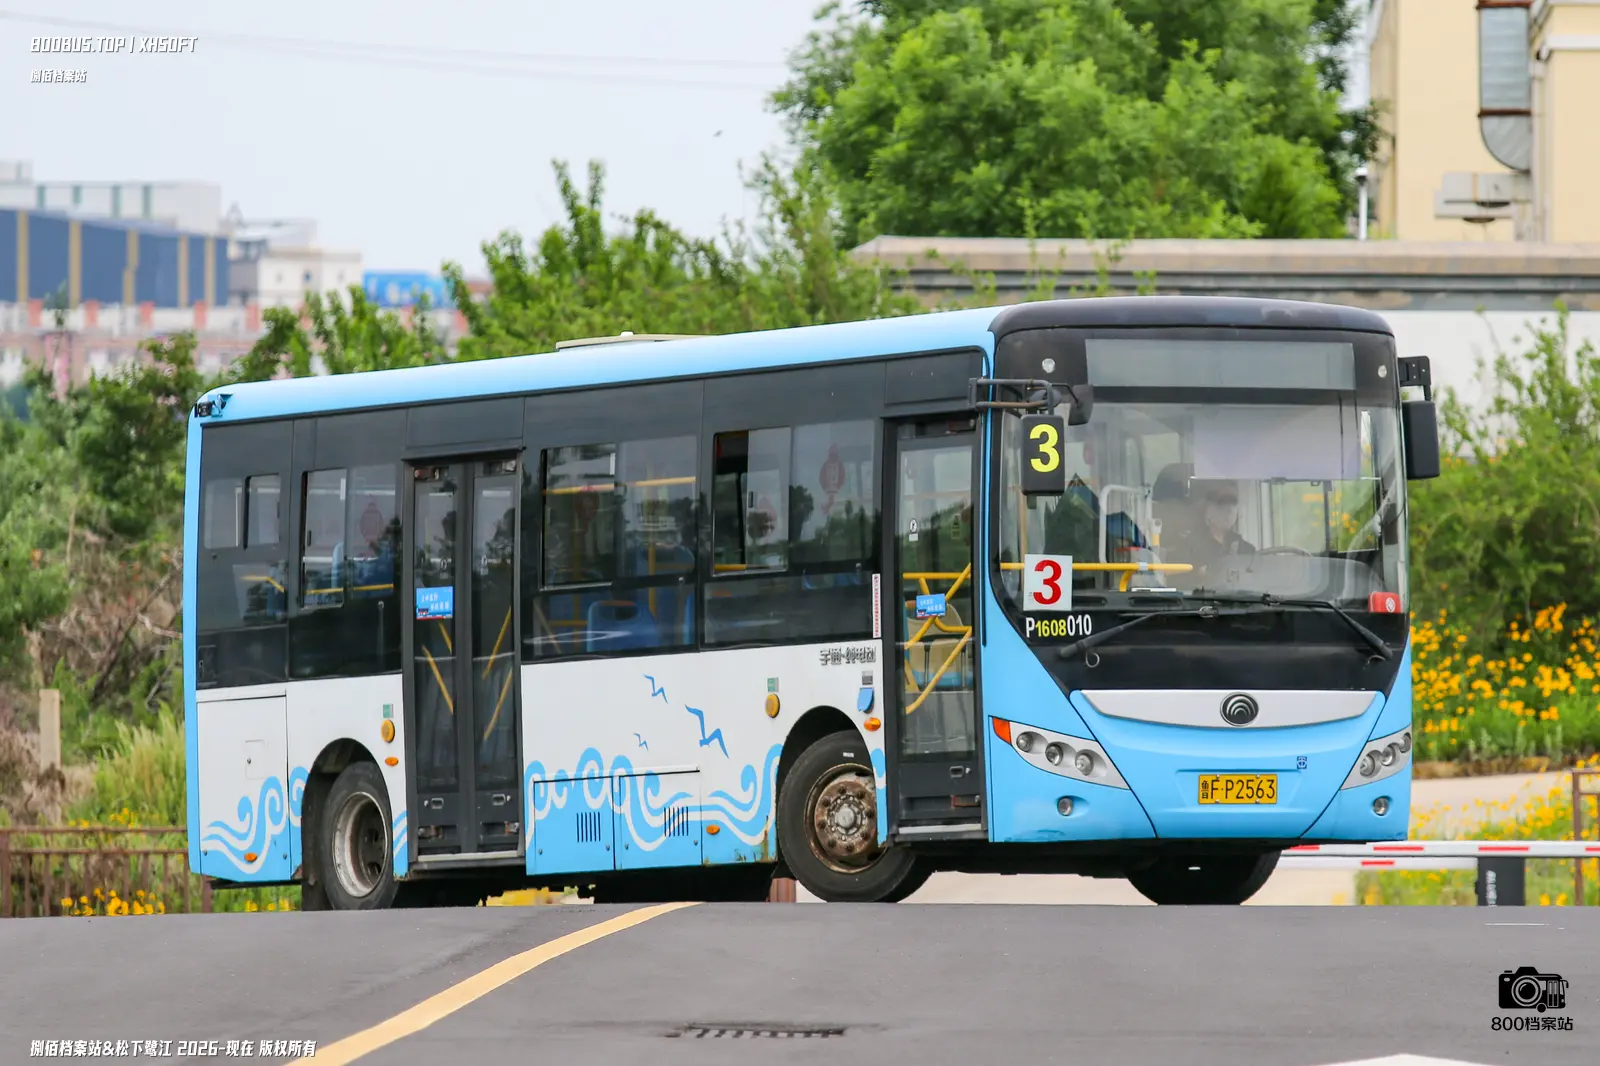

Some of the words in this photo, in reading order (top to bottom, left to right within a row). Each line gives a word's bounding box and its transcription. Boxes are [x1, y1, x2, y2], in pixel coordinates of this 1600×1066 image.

[1029, 424, 1060, 473] 3
[1033, 559, 1062, 605] 3
[1026, 614, 1093, 638] P1608010
